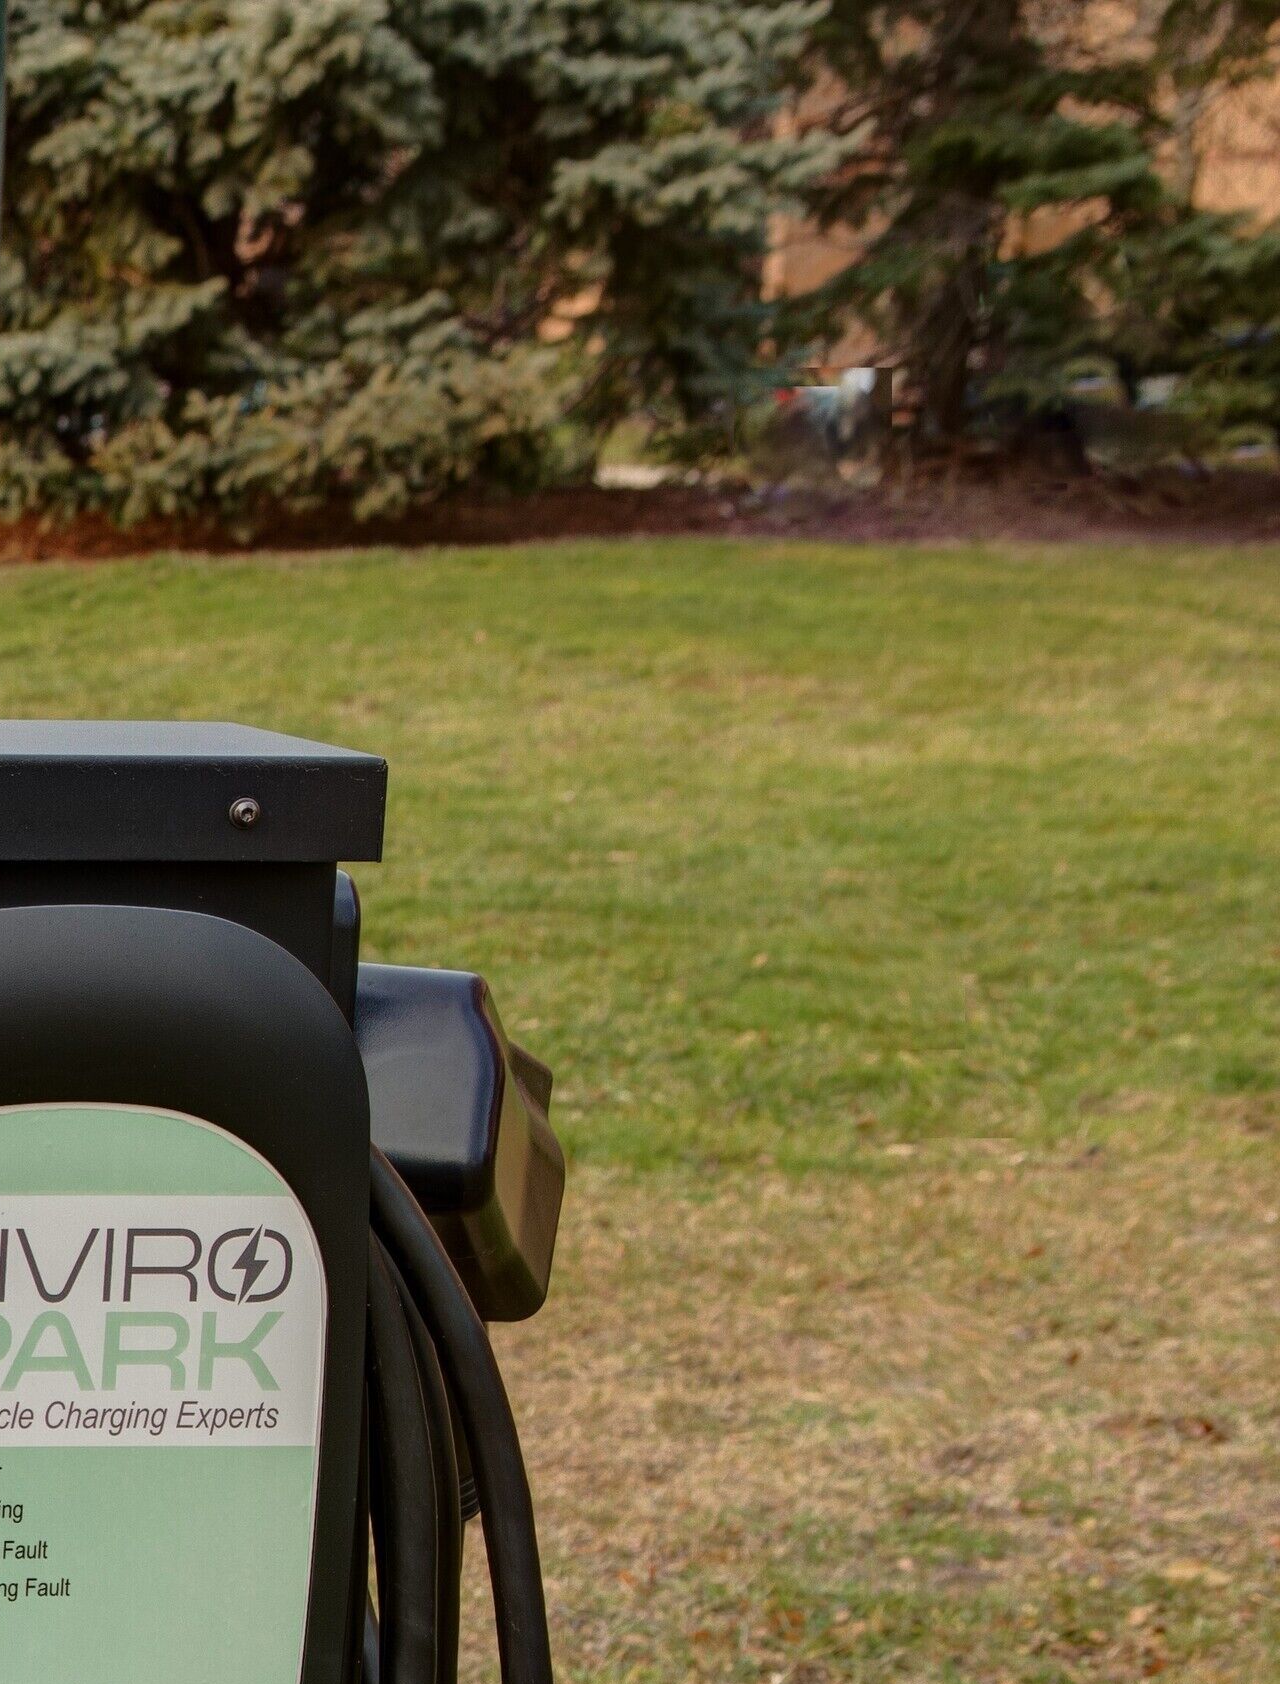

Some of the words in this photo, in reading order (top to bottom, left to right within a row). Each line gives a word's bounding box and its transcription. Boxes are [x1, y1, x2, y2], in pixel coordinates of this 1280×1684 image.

[44, 1400, 168, 1437] Charging
[175, 1400, 280, 1436] Experts
[2, 1539, 49, 1560] Fault
[25, 1577, 71, 1597] Fault
